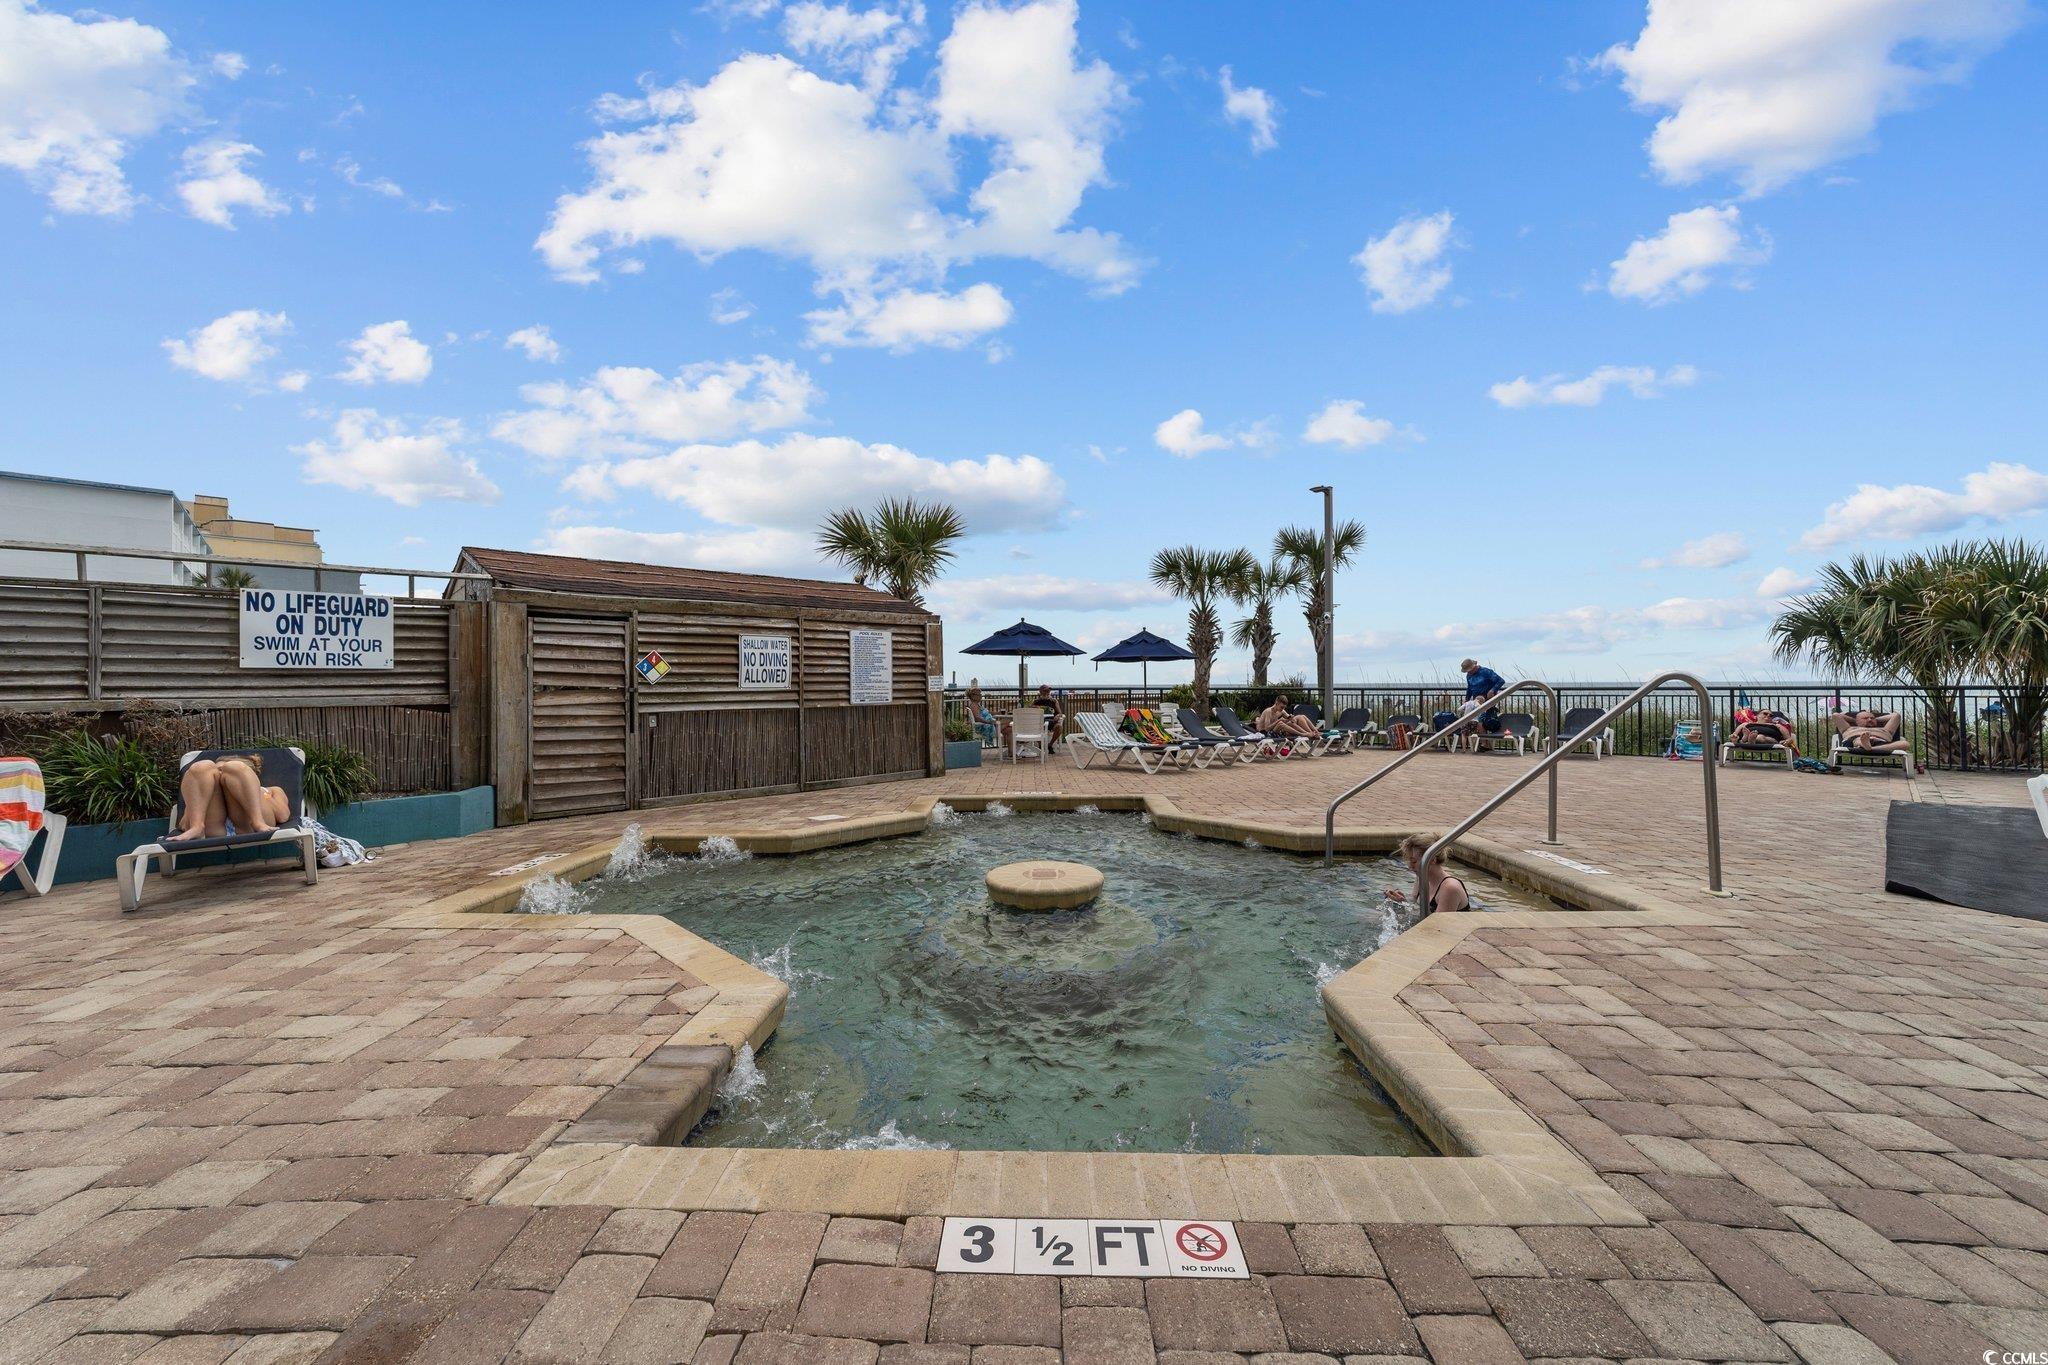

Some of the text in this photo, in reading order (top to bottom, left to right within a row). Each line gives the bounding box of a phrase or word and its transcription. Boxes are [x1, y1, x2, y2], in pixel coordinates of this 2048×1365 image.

[246, 591, 389, 617] NO LIFEGUARD
[276, 614, 363, 636] ON DUTY
[254, 636, 382, 652] SWIM AT YOUR
[743, 639, 788, 650] SHALLOW WATER
[276, 652, 363, 666] OWN RISK
[744, 652, 788, 667] NO DIVING
[744, 668, 787, 683] ALLOWED
[959, 1224, 995, 1263] 3
[1095, 1226, 1154, 1266] FT
